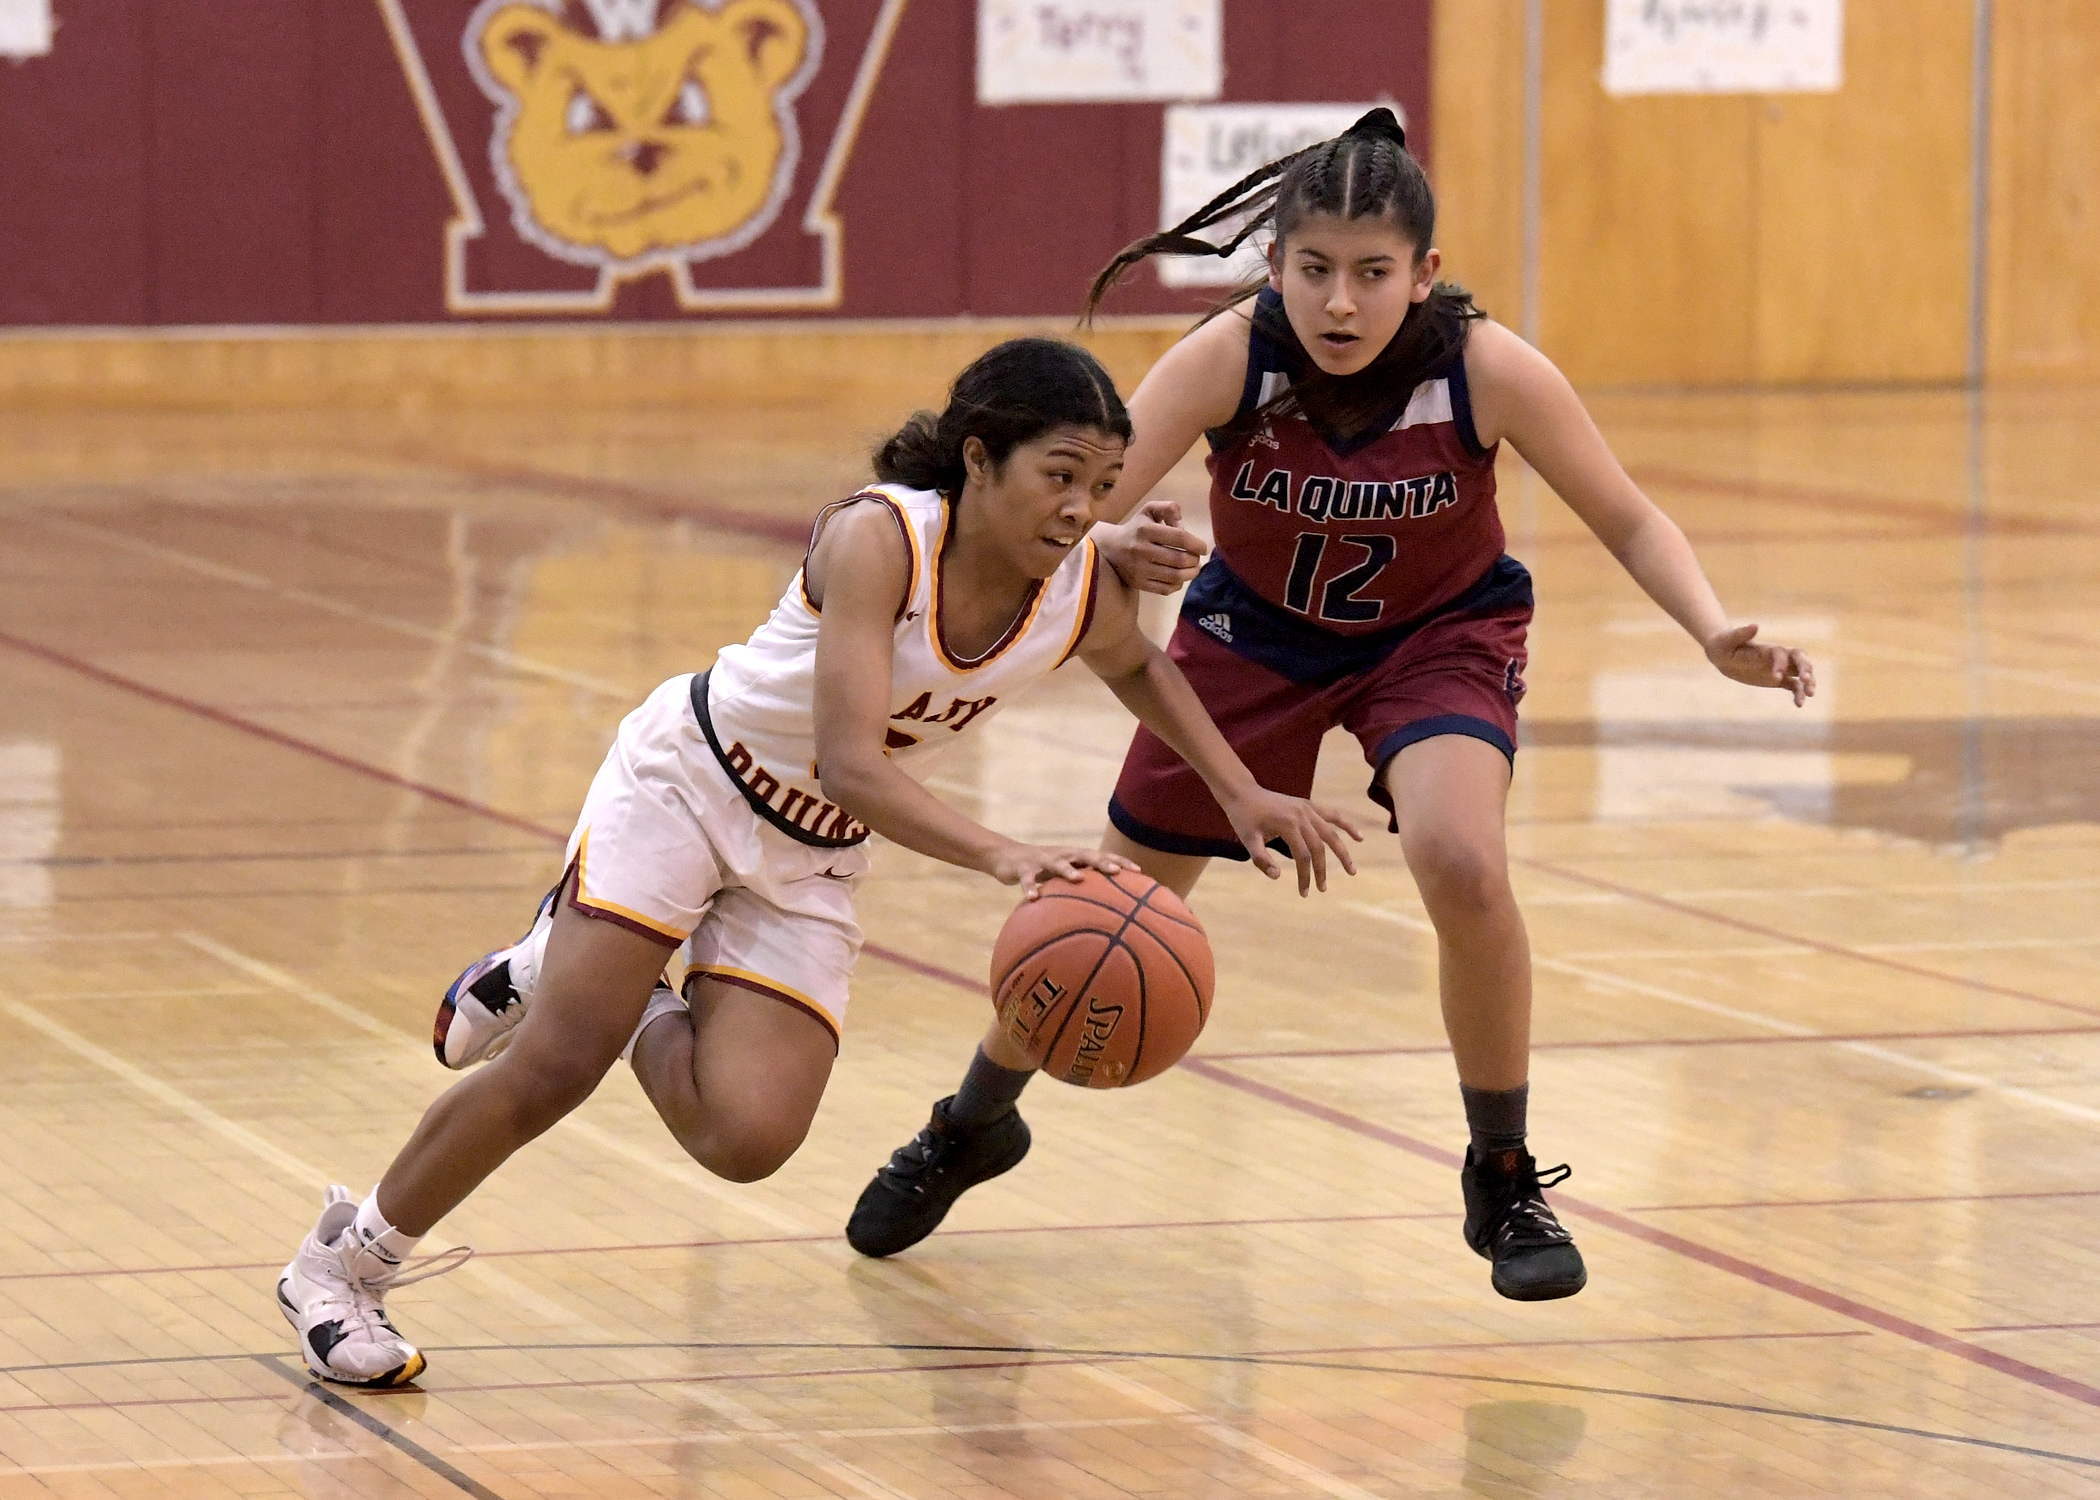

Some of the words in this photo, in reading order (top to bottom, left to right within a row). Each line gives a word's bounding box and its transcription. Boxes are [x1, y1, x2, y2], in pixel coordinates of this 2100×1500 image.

[1230, 459, 1292, 514] LA
[1296, 471, 1459, 524] QUINTA
[1284, 532, 1397, 623] 12
[1199, 617, 1234, 643] adidas
